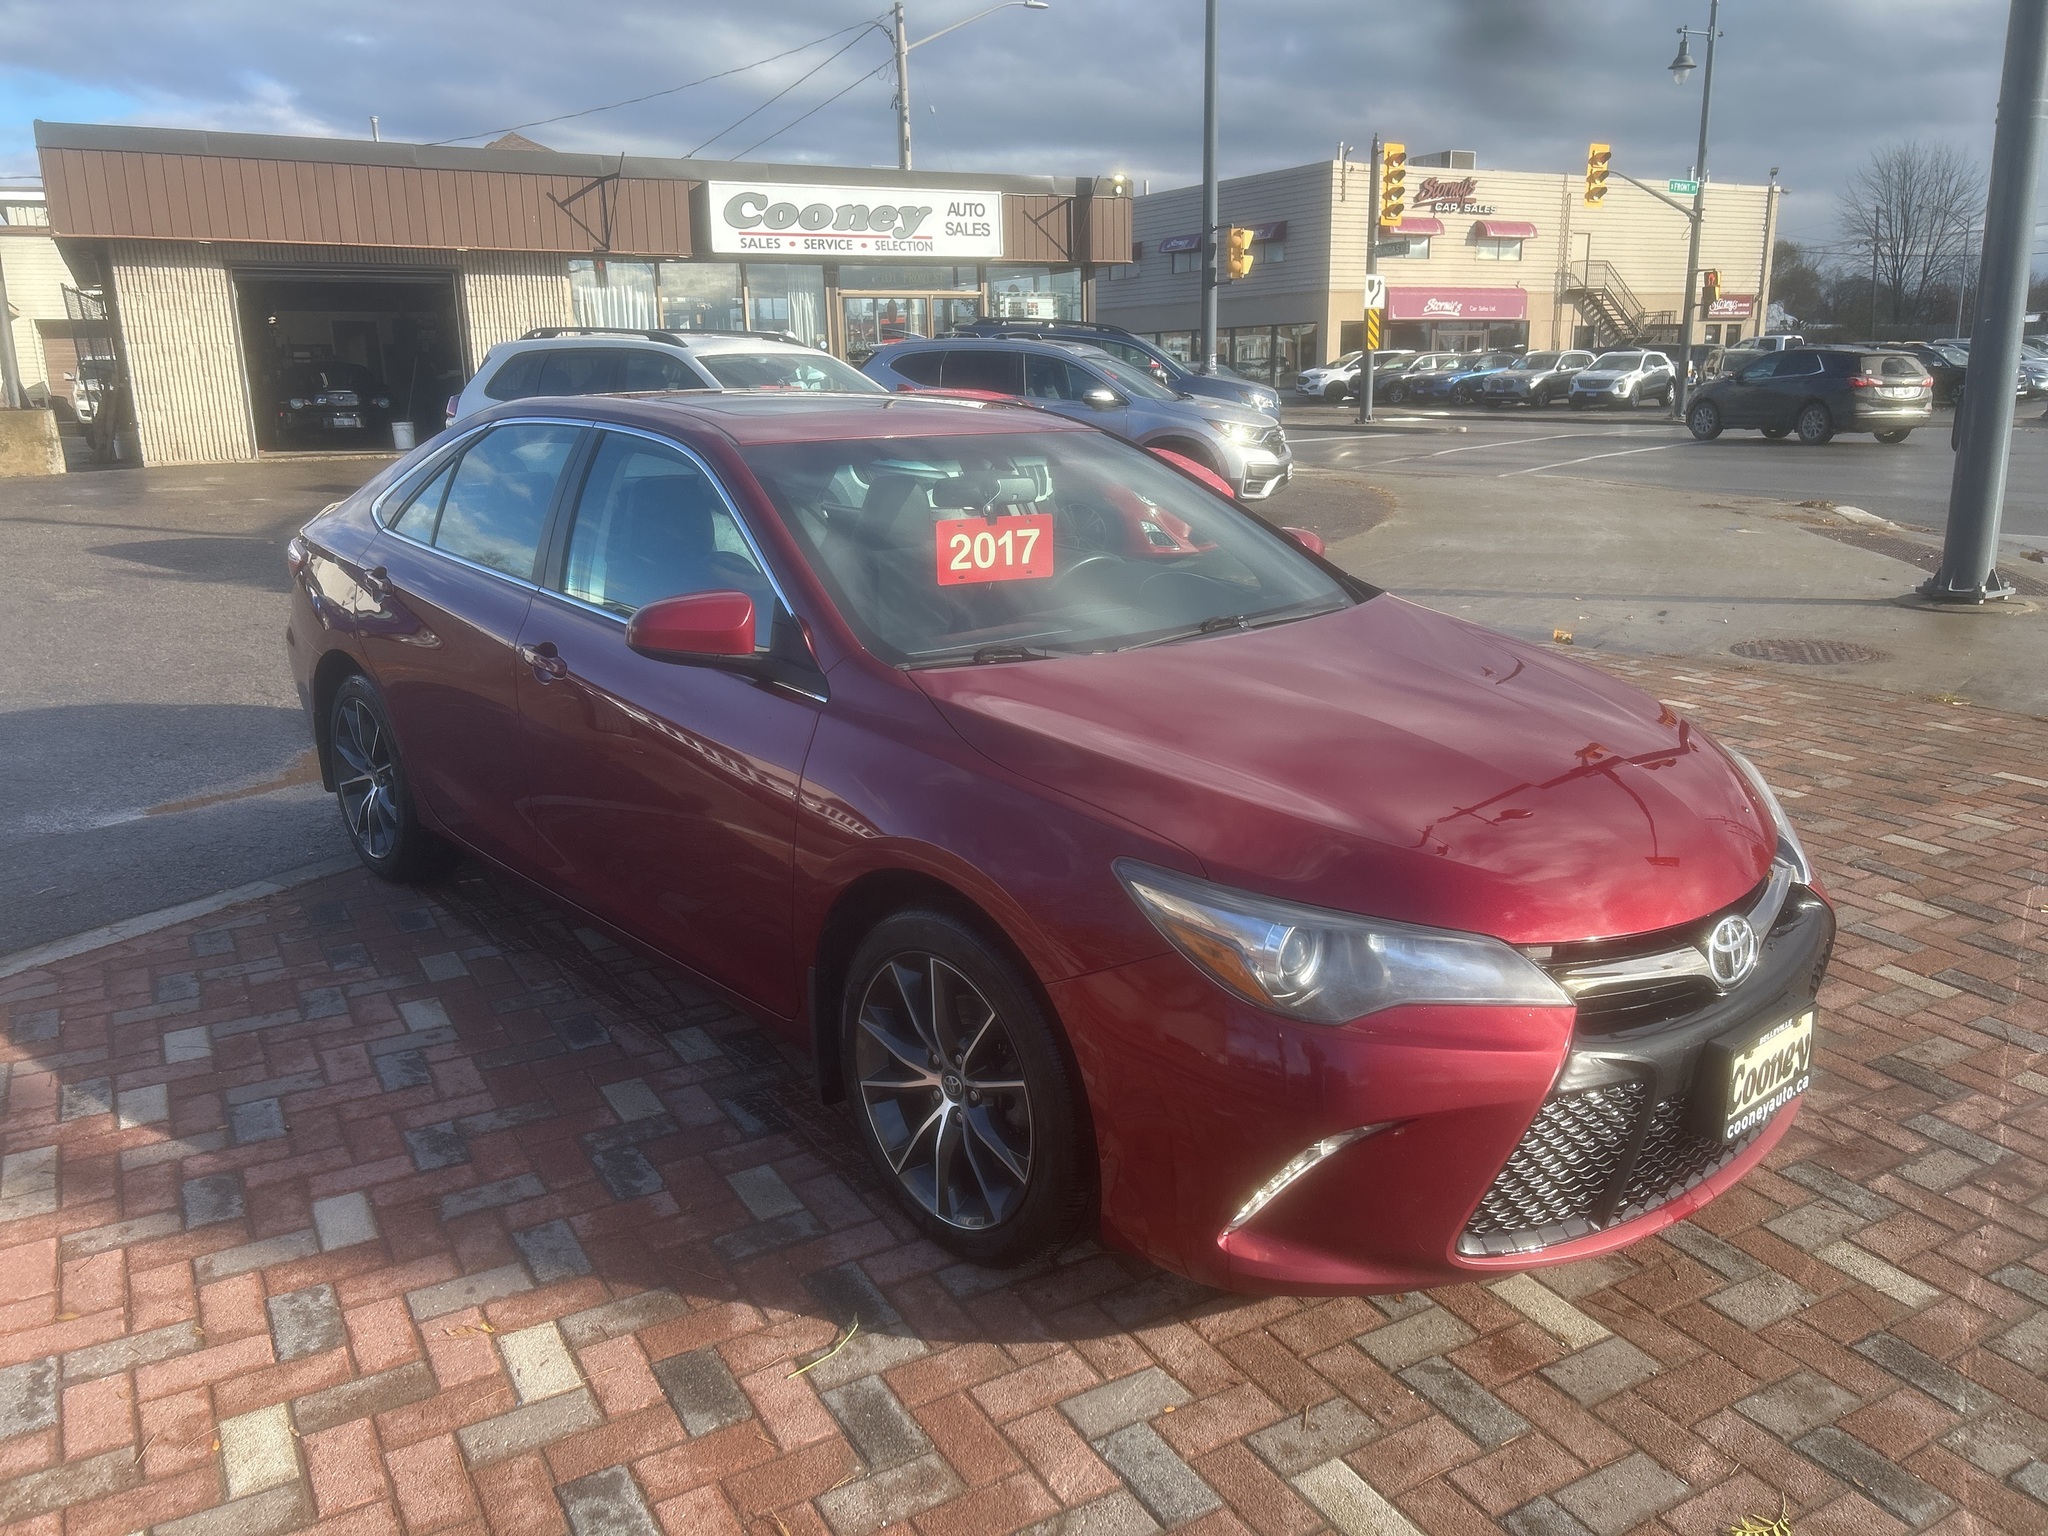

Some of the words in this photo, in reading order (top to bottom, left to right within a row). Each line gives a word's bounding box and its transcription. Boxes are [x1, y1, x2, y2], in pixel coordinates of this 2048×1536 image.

[1674, 182, 1691, 192] FRONT
[724, 191, 933, 239] Cooney
[946, 202, 986, 217] AUTO
[1435, 203, 1460, 213] CAR
[1464, 205, 1497, 213] SALES
[945, 222, 991, 238] SALES
[740, 238, 781, 249] SALES
[803, 239, 853, 250] SERVICE
[874, 240, 933, 252] SELECTION
[949, 528, 1041, 571] 2017
[1758, 1018, 1793, 1046] BELLEVILLE
[1728, 1032, 1811, 1117] Cooney
[1726, 1075, 1809, 1139] cooneyauto.ca
